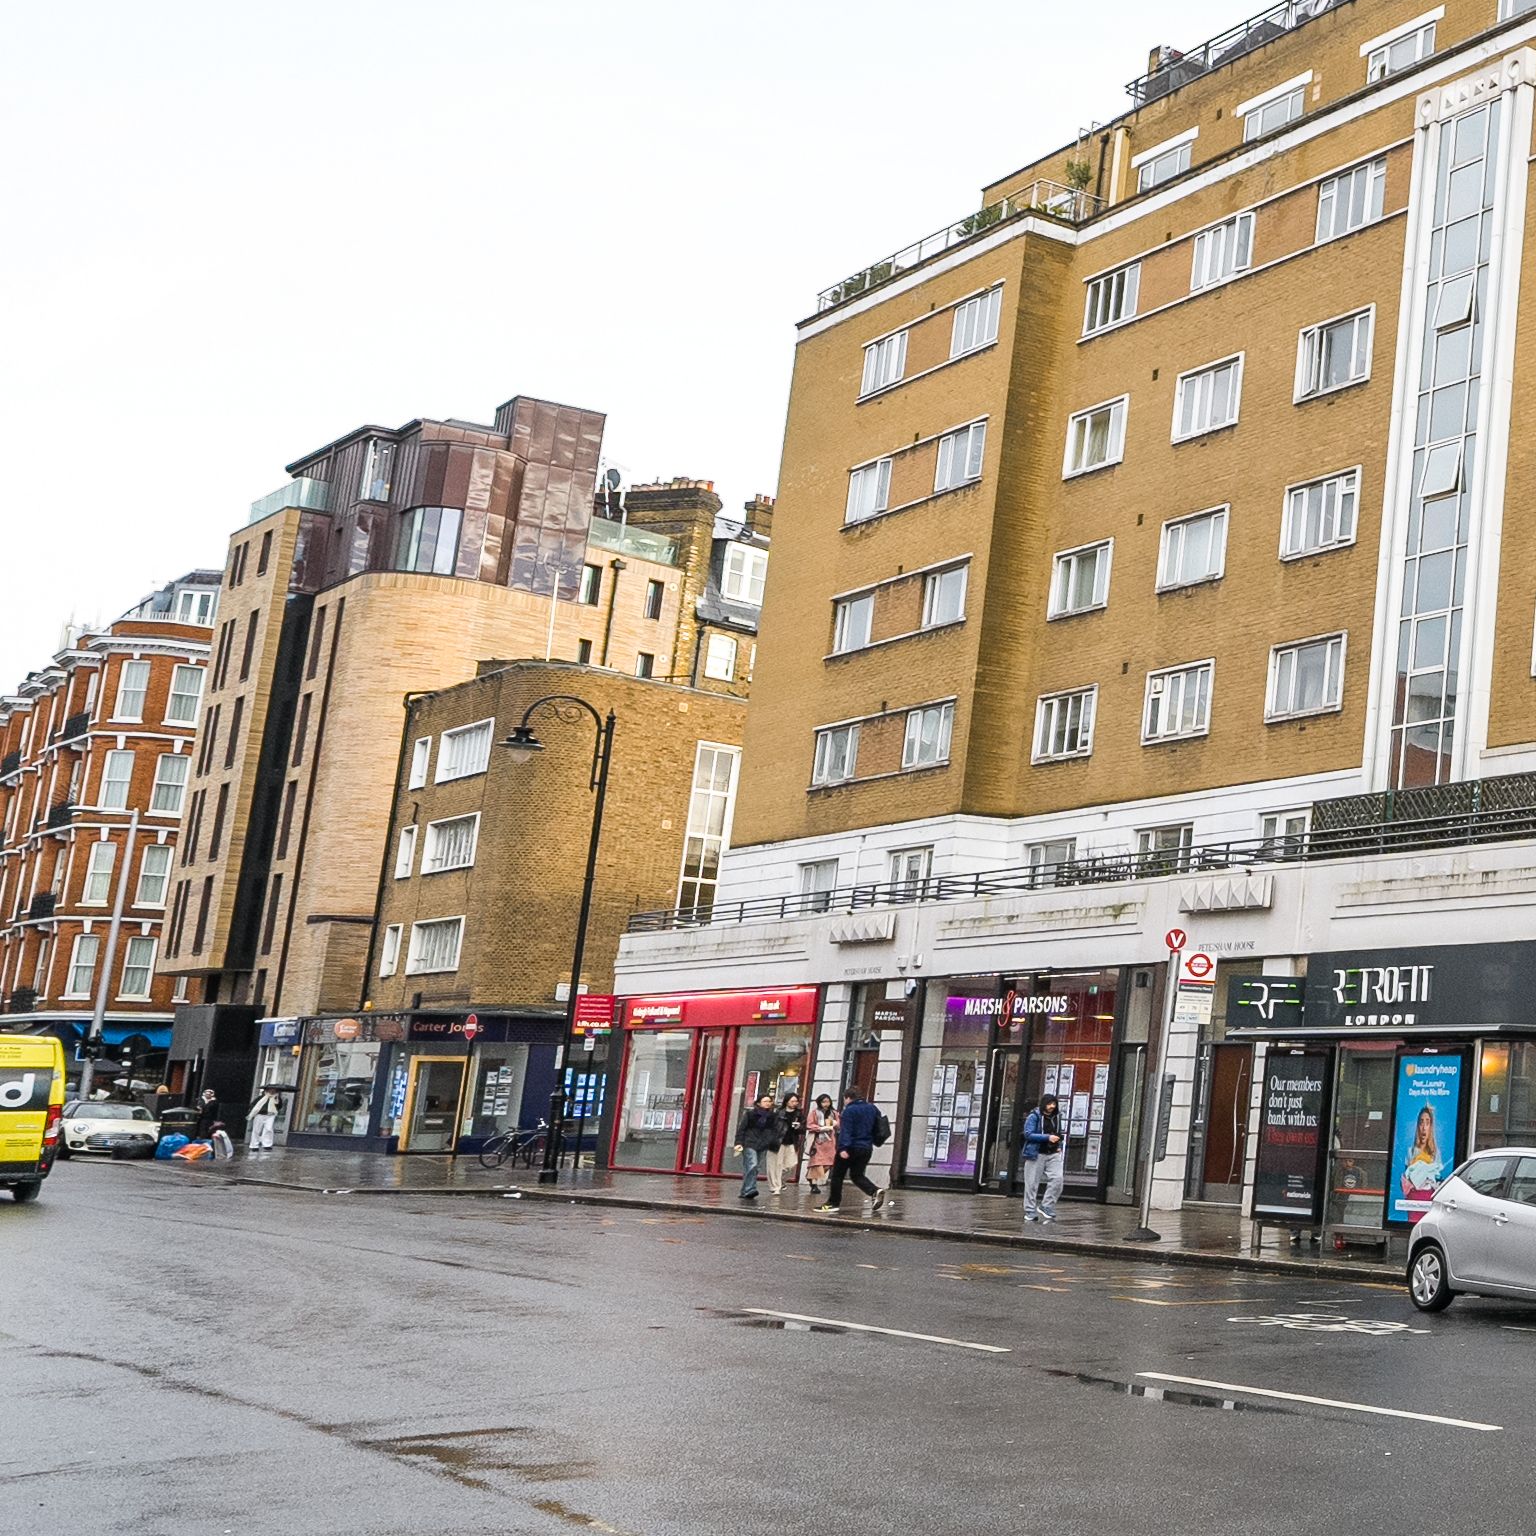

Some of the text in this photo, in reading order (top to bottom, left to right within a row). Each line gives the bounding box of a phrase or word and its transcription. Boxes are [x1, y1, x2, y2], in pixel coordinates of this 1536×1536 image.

[1170, 932, 1184, 948] V
[1332, 965, 1434, 1004] RETROFIT
[965, 990, 1068, 1027] MARSH & PARSONS
[413, 1022, 484, 1034] Carter Jos
[1345, 1014, 1415, 1026] LONDON
[1414, 1064, 1457, 1076] laundryheap
[1270, 1075, 1322, 1092] Our members
[1268, 1093, 1303, 1112] don't just
[1267, 1109, 1317, 1126] bank with us.
